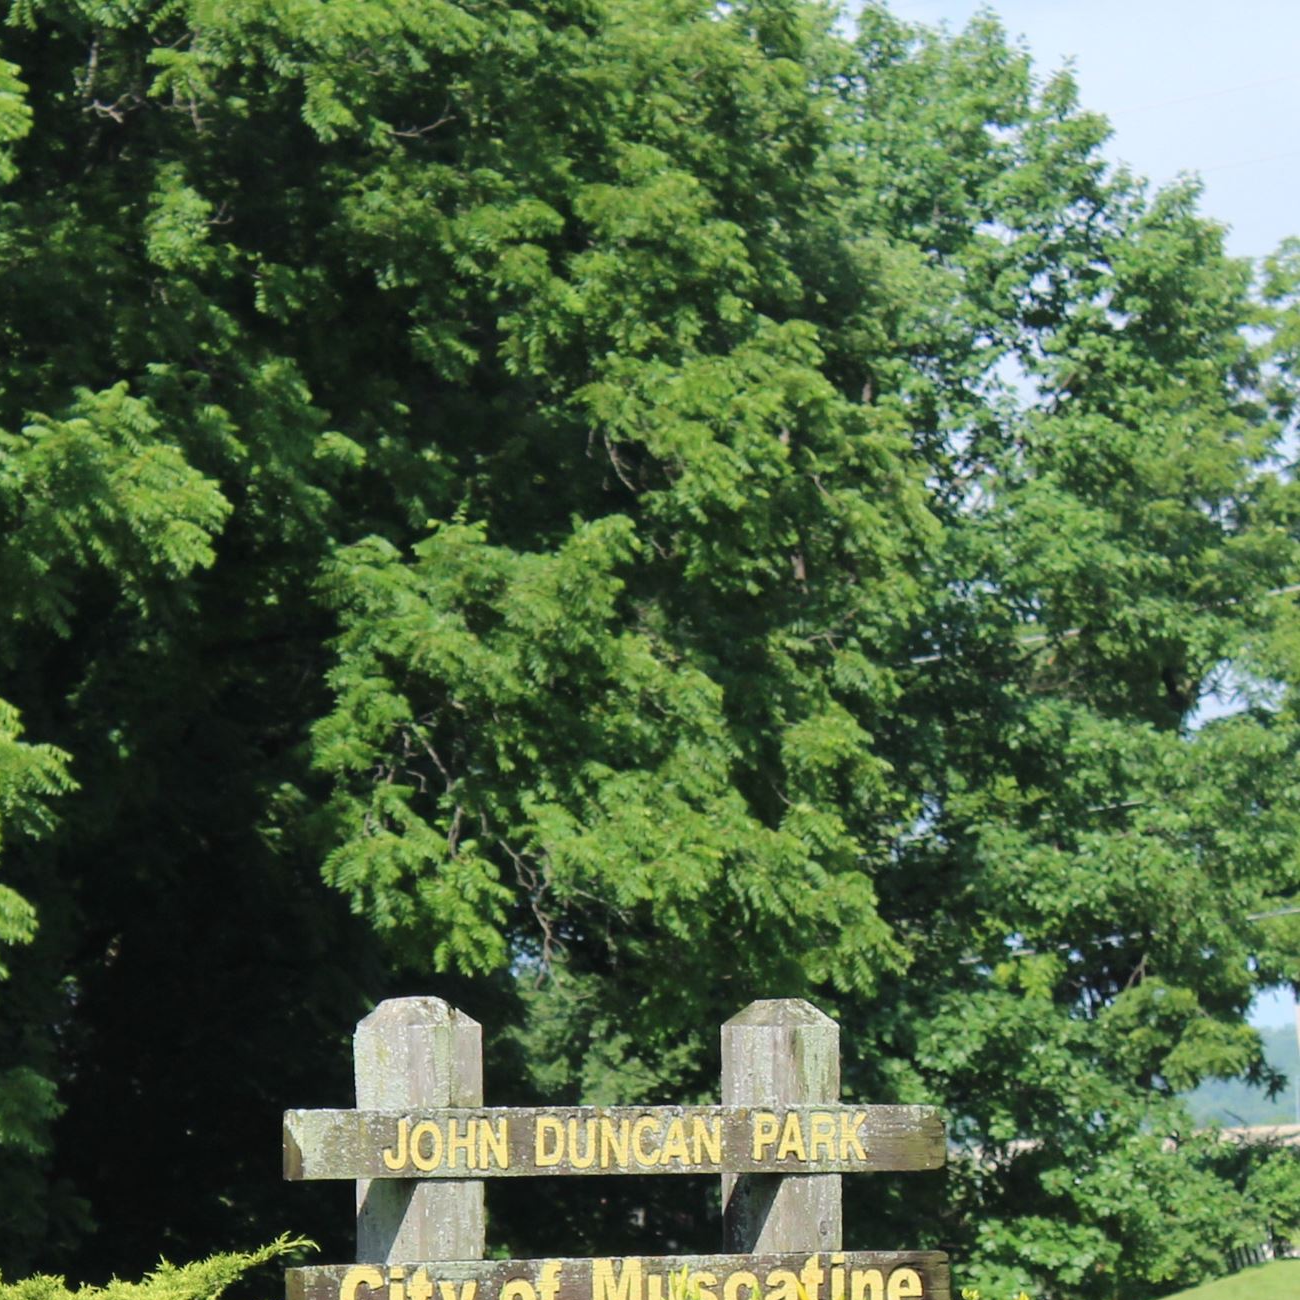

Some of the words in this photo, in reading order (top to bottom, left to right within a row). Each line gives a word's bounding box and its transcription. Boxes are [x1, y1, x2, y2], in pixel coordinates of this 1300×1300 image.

[383, 1118, 508, 1171] JOHN
[535, 1115, 722, 1169] DUNCAN
[752, 1111, 868, 1162] PARK
